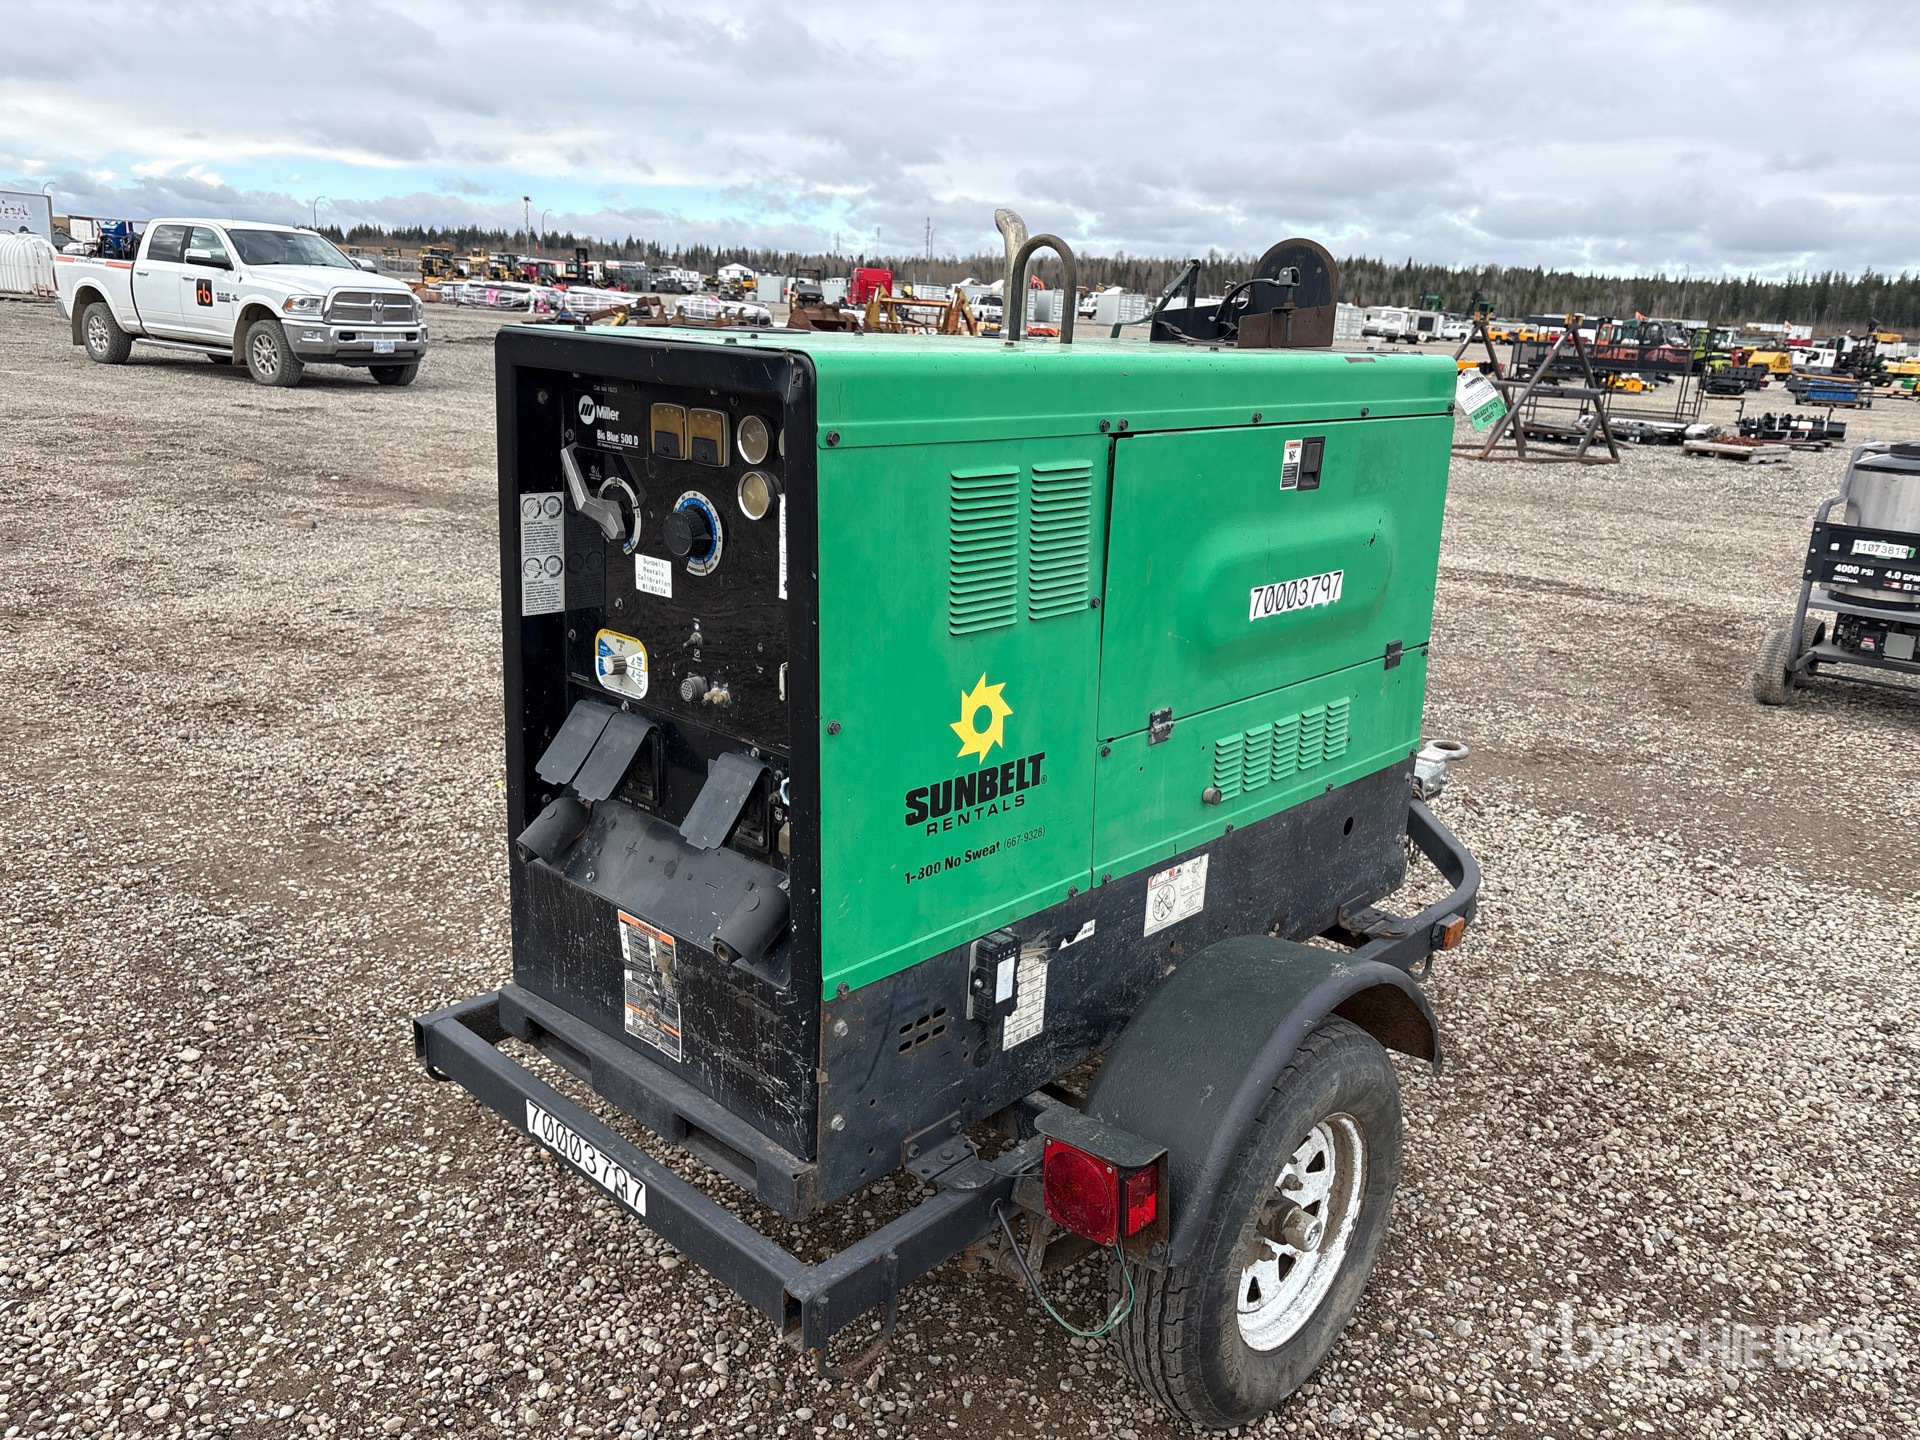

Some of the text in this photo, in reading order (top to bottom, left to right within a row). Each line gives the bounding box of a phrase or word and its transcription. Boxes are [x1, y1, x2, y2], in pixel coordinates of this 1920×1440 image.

[596, 404, 620, 421] Miller
[596, 429, 639, 446] Big Blue 500 D
[1855, 543, 1908, 556] 11073819
[642, 557, 665, 569] Sunbelt
[637, 573, 671, 588] Calibration
[642, 566, 665, 578] Rentals
[1834, 563, 1860, 575] 4000
[1860, 568, 1875, 577] PSI
[1884, 570, 1902, 581] 4.0
[1253, 571, 1343, 616] 70003797
[904, 751, 1046, 827] SUNBELT
[925, 792, 1026, 838] RENTALS
[944, 855, 961, 871] No
[964, 841, 1001, 863] Sweat
[1003, 824, 1046, 851] (667-9328)
[528, 1099, 644, 1208] 70003797
